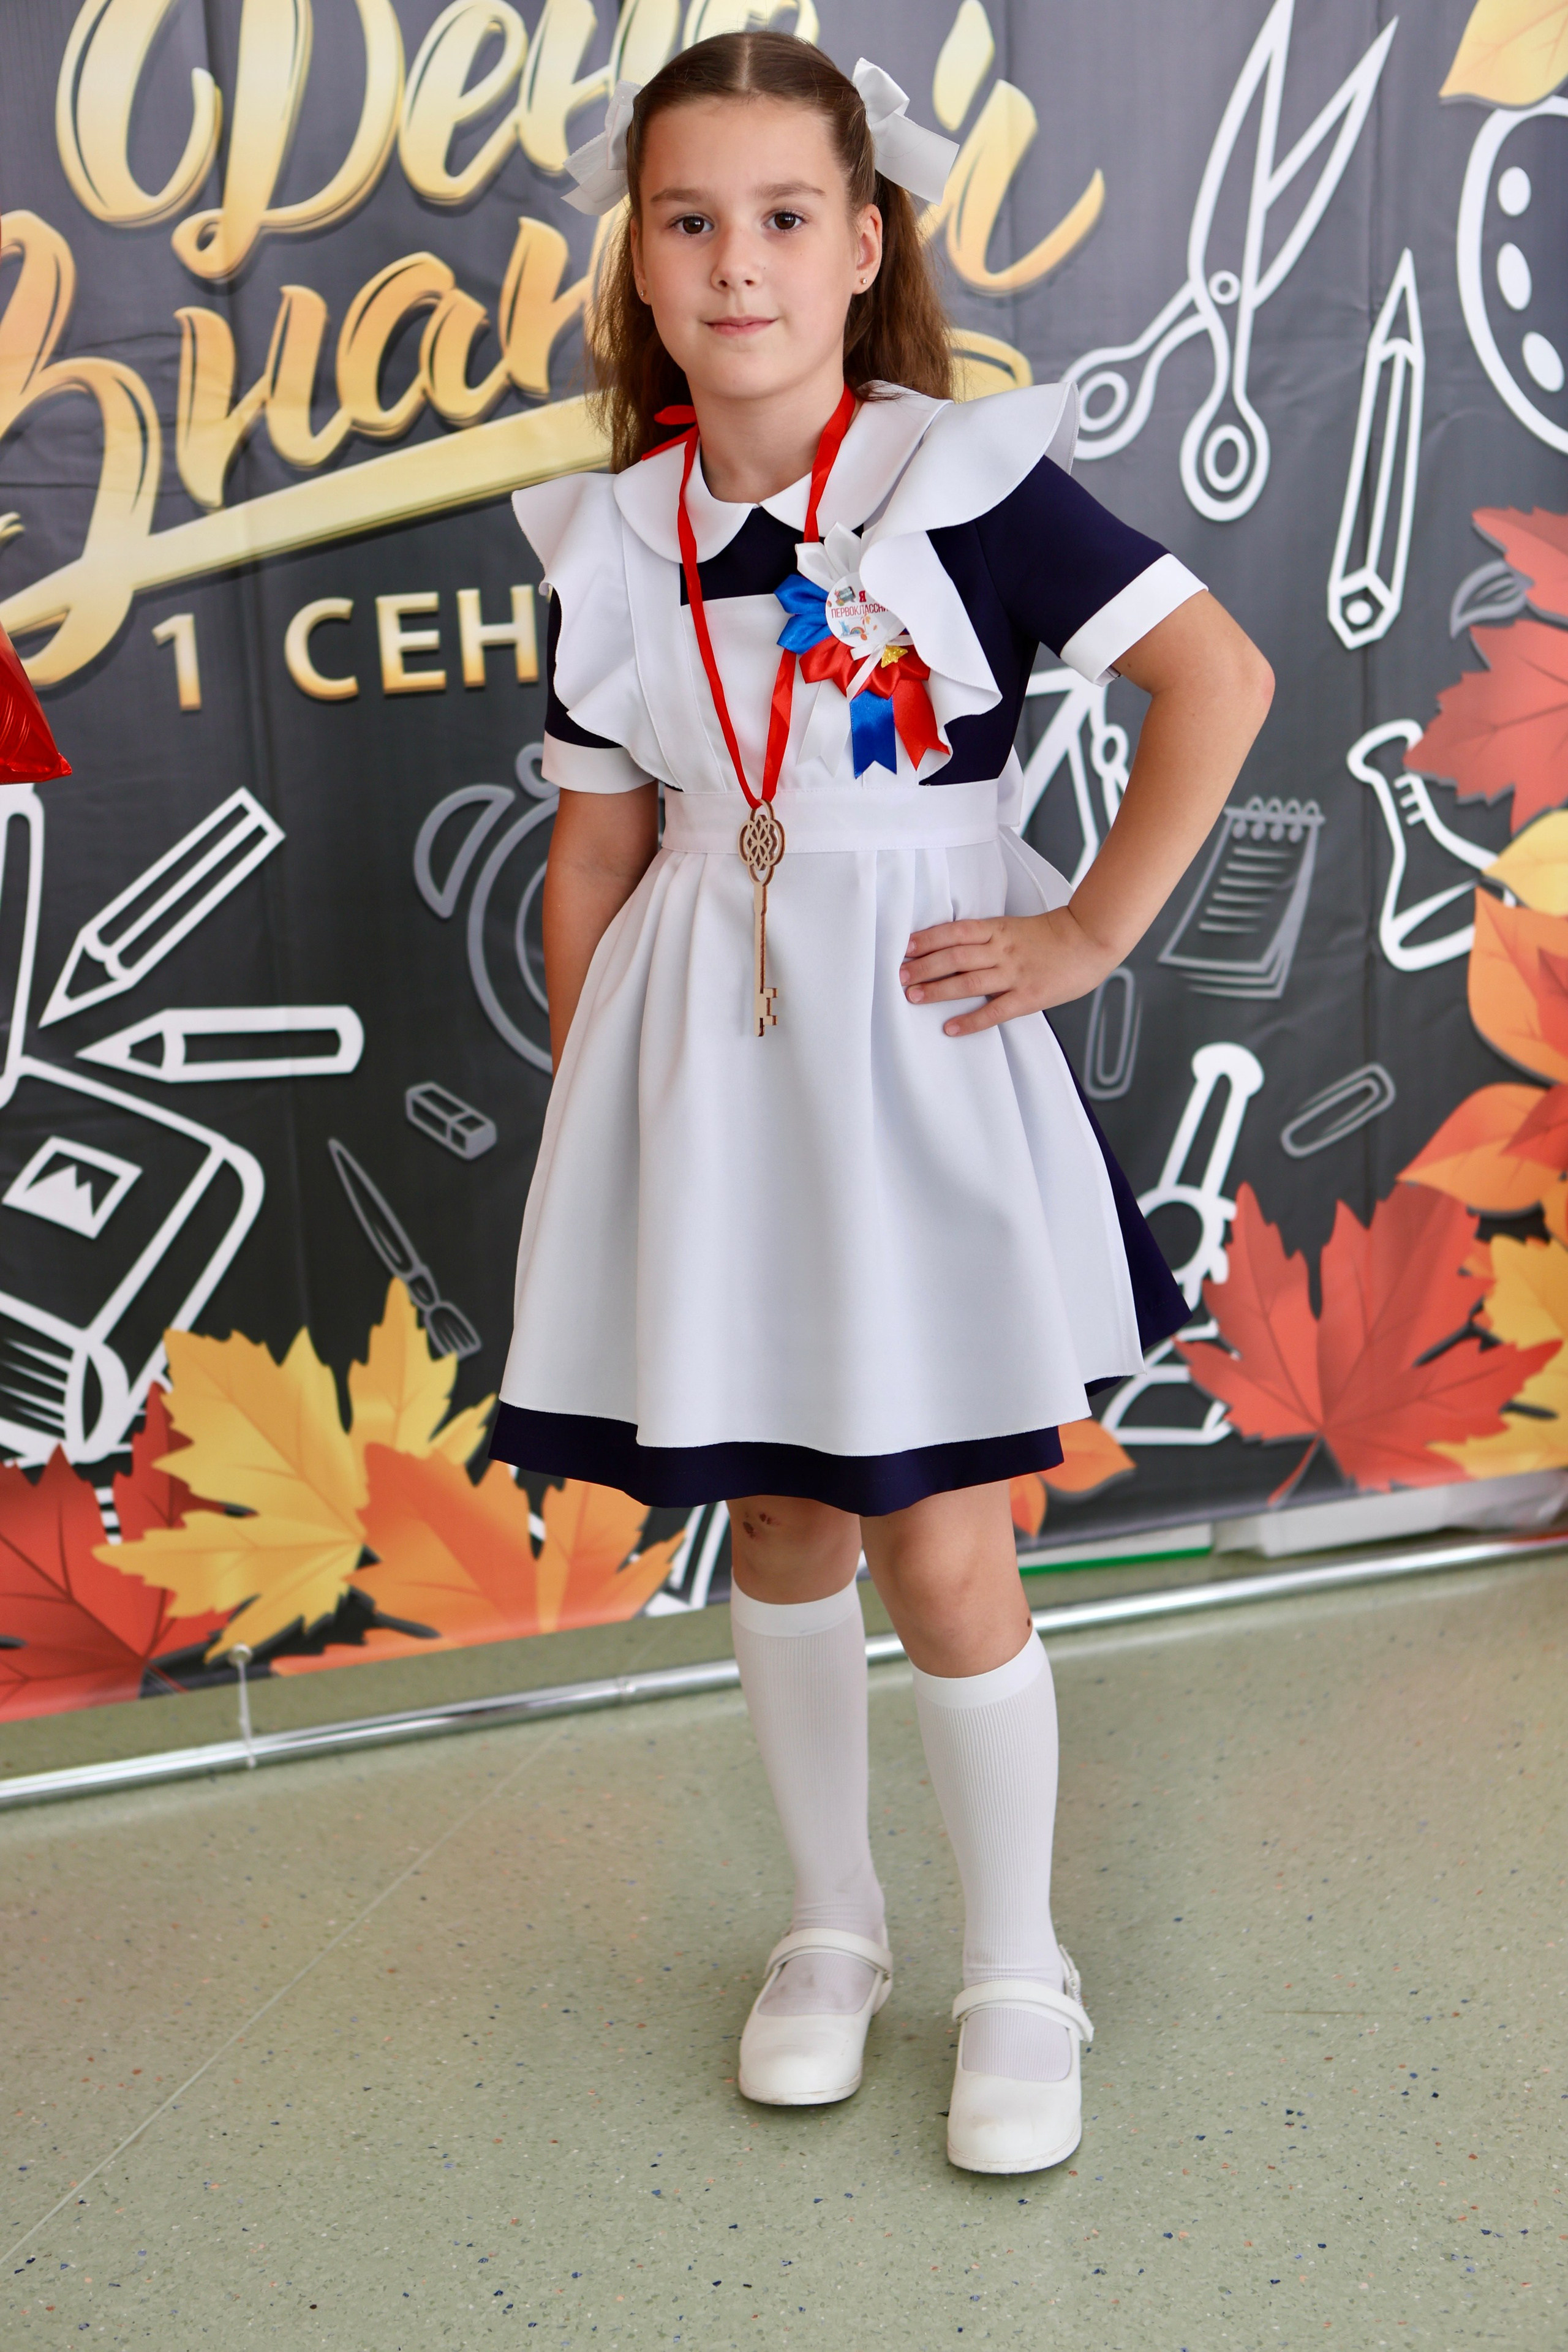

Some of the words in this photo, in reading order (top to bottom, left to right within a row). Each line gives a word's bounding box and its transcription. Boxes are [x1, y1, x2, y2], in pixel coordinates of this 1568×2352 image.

[859, 590, 867, 603] Я
[153, 613, 201, 711] 1
[284, 584, 553, 701] СЕН
